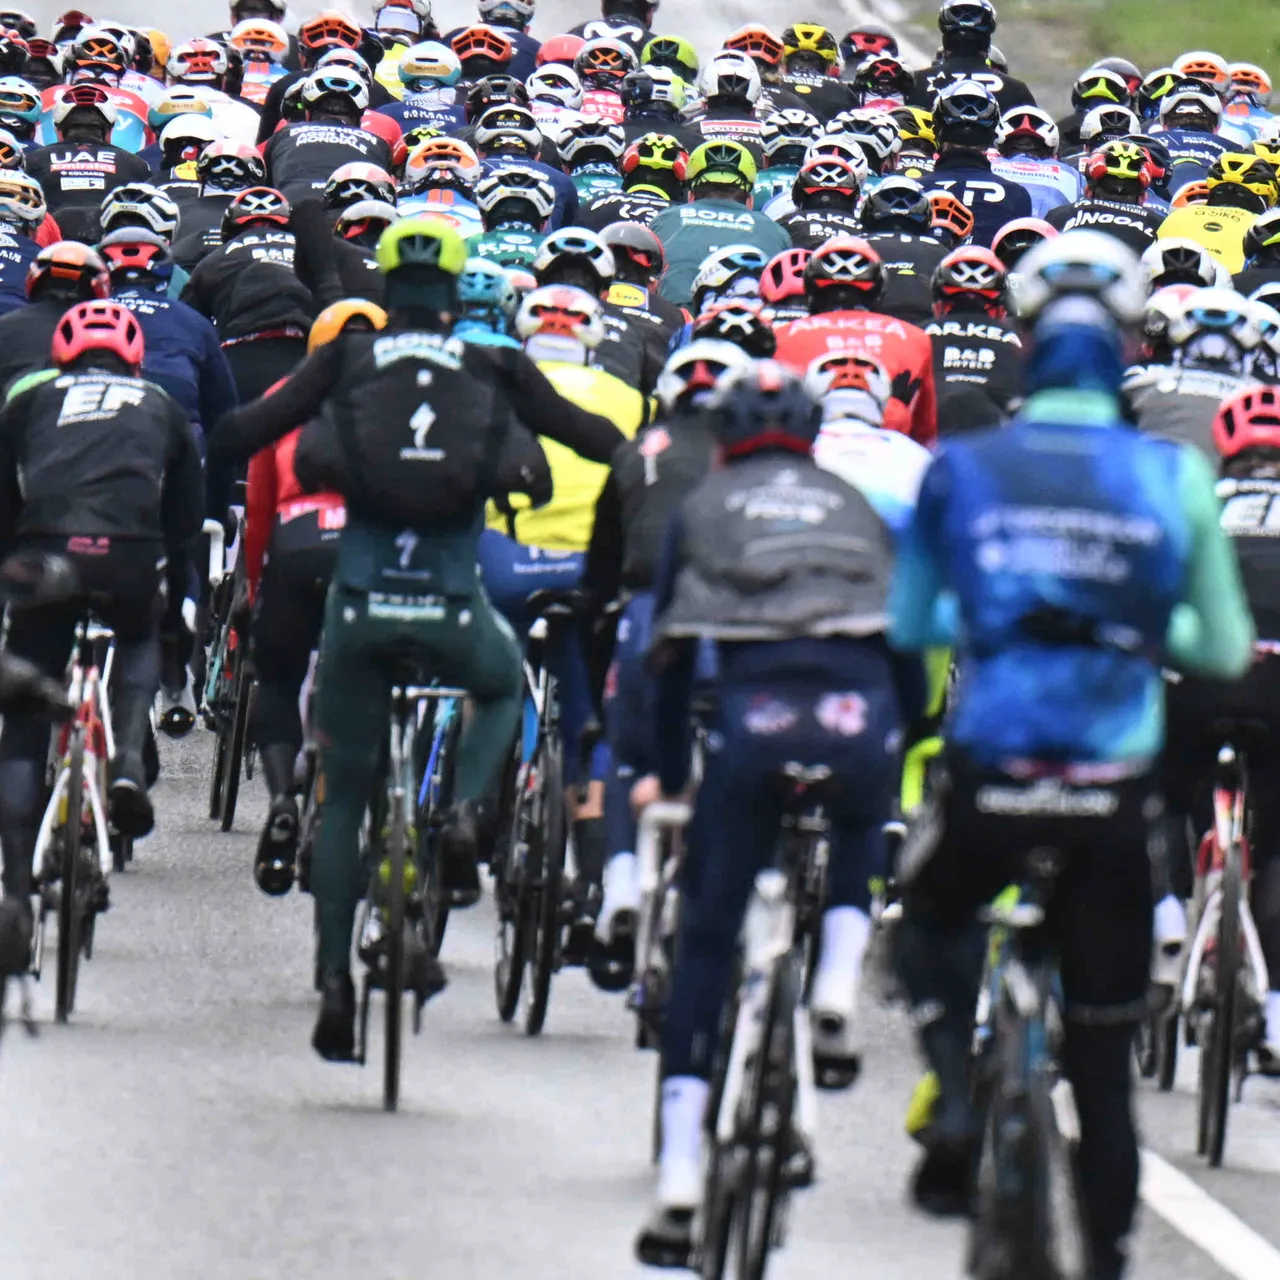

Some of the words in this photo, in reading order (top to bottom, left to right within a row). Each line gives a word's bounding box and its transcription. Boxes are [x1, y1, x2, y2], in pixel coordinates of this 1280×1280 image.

[50, 151, 116, 164] UAE
[680, 207, 755, 225] BORA
[789, 214, 864, 230] ARKE
[1063, 210, 1154, 237] BINGOAL
[225, 233, 296, 254] ARKE
[789, 319, 907, 340] ARKEA
[925, 322, 1023, 348] ARKEA
[944, 347, 995, 361] B&B
